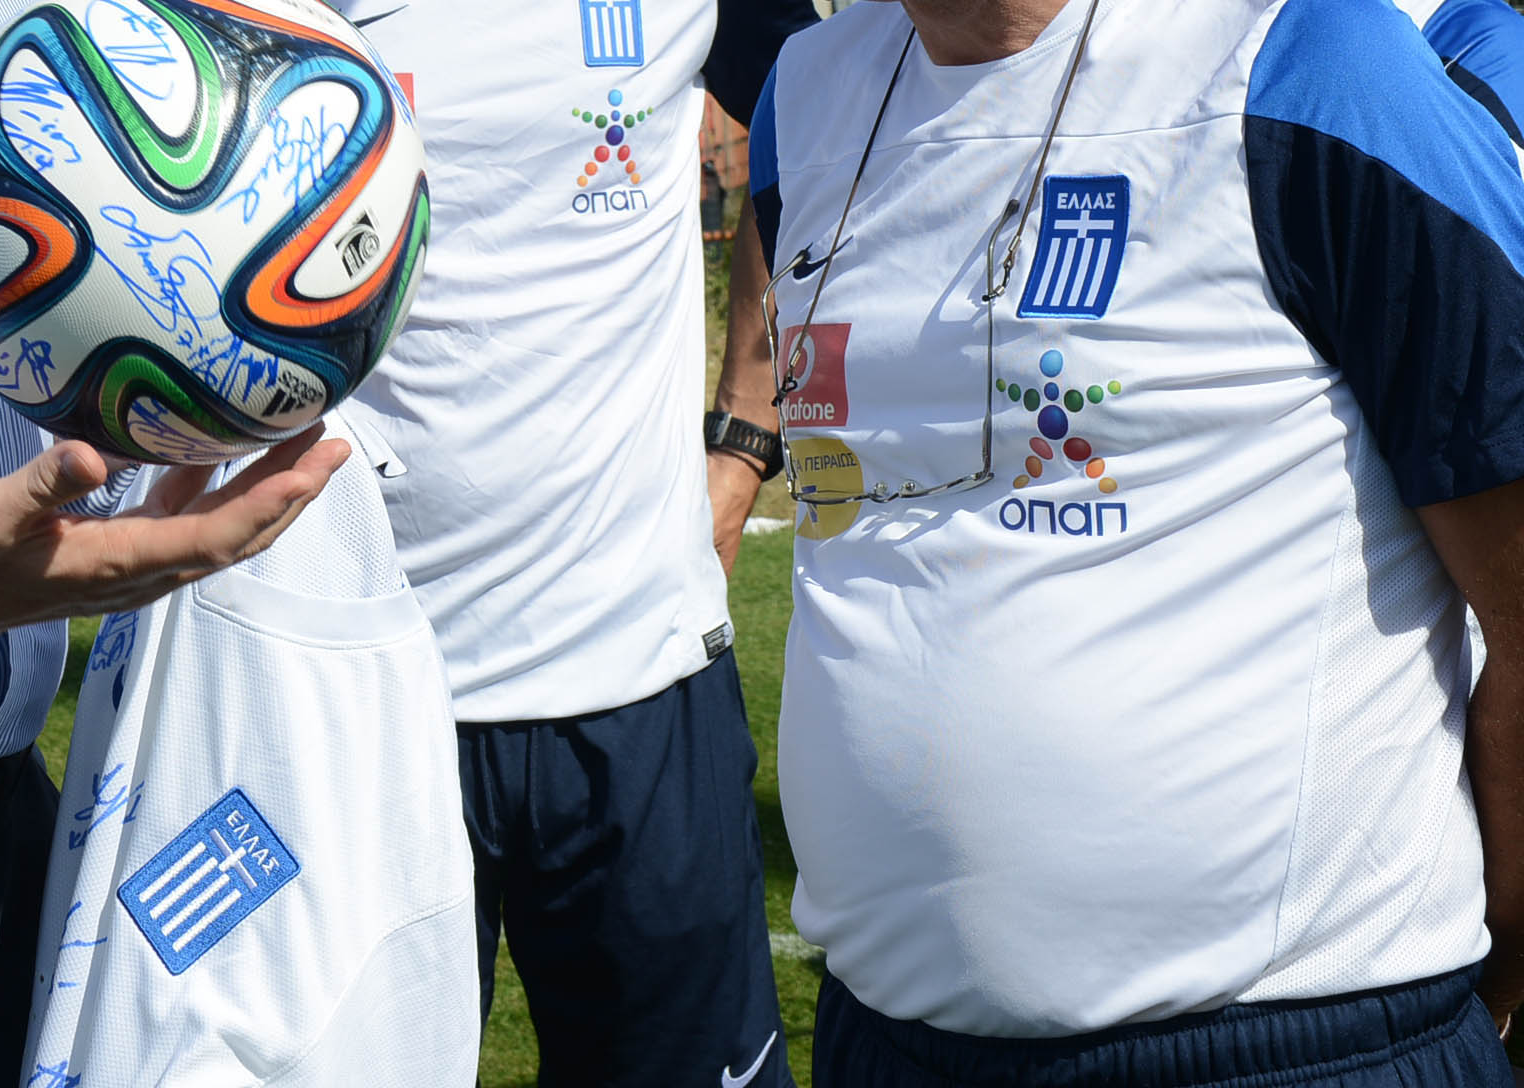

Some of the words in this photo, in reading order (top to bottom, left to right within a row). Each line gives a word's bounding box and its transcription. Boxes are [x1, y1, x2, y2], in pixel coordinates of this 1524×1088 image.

[1057, 191, 1116, 210] ΕΛΛΑΣ
[781, 397, 835, 421] dafone
[804, 452, 858, 473] ΠΕΙΡΑΙΩΣ
[226, 809, 280, 876] ΕΛΛΑΣ
